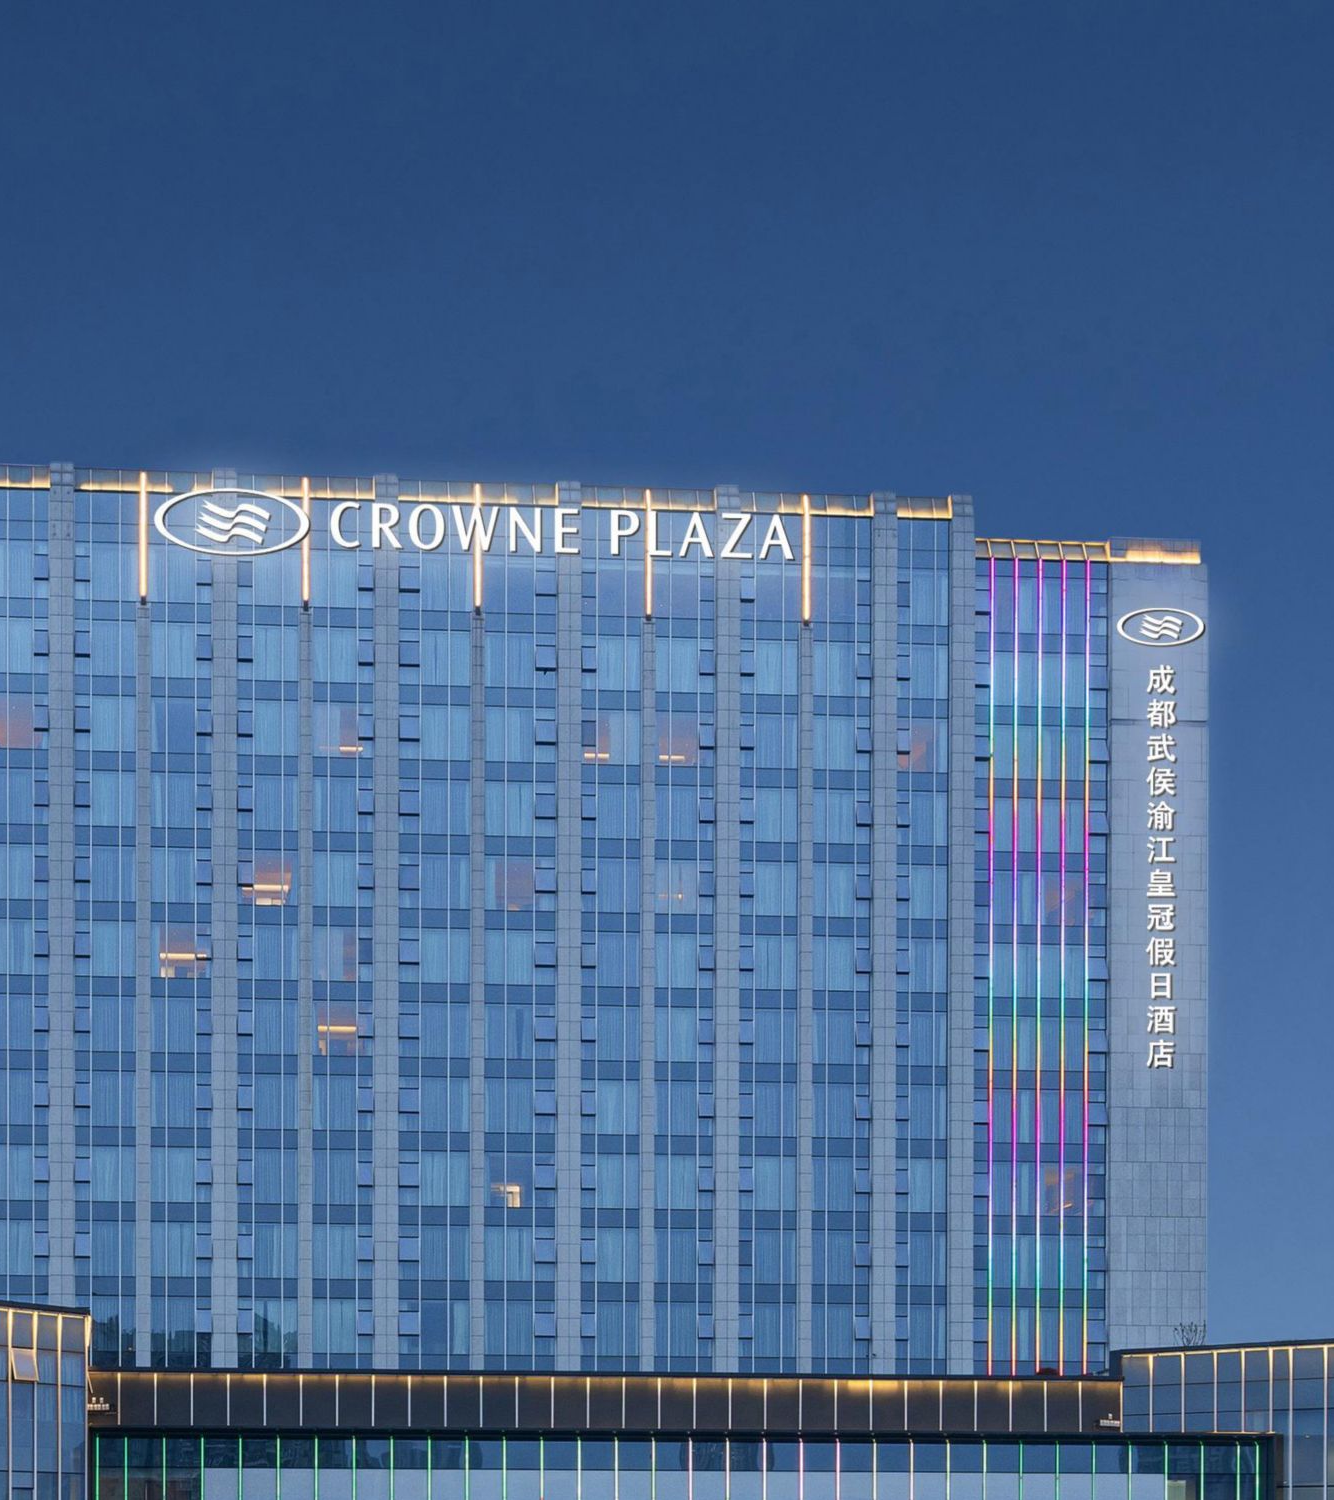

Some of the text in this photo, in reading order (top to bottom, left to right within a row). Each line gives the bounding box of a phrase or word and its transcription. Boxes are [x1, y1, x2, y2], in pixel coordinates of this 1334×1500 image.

[329, 500, 797, 562] CROWNE PLAZA
[1145, 664, 1178, 1069] 成都武侯渝江皇冠假日酒店
